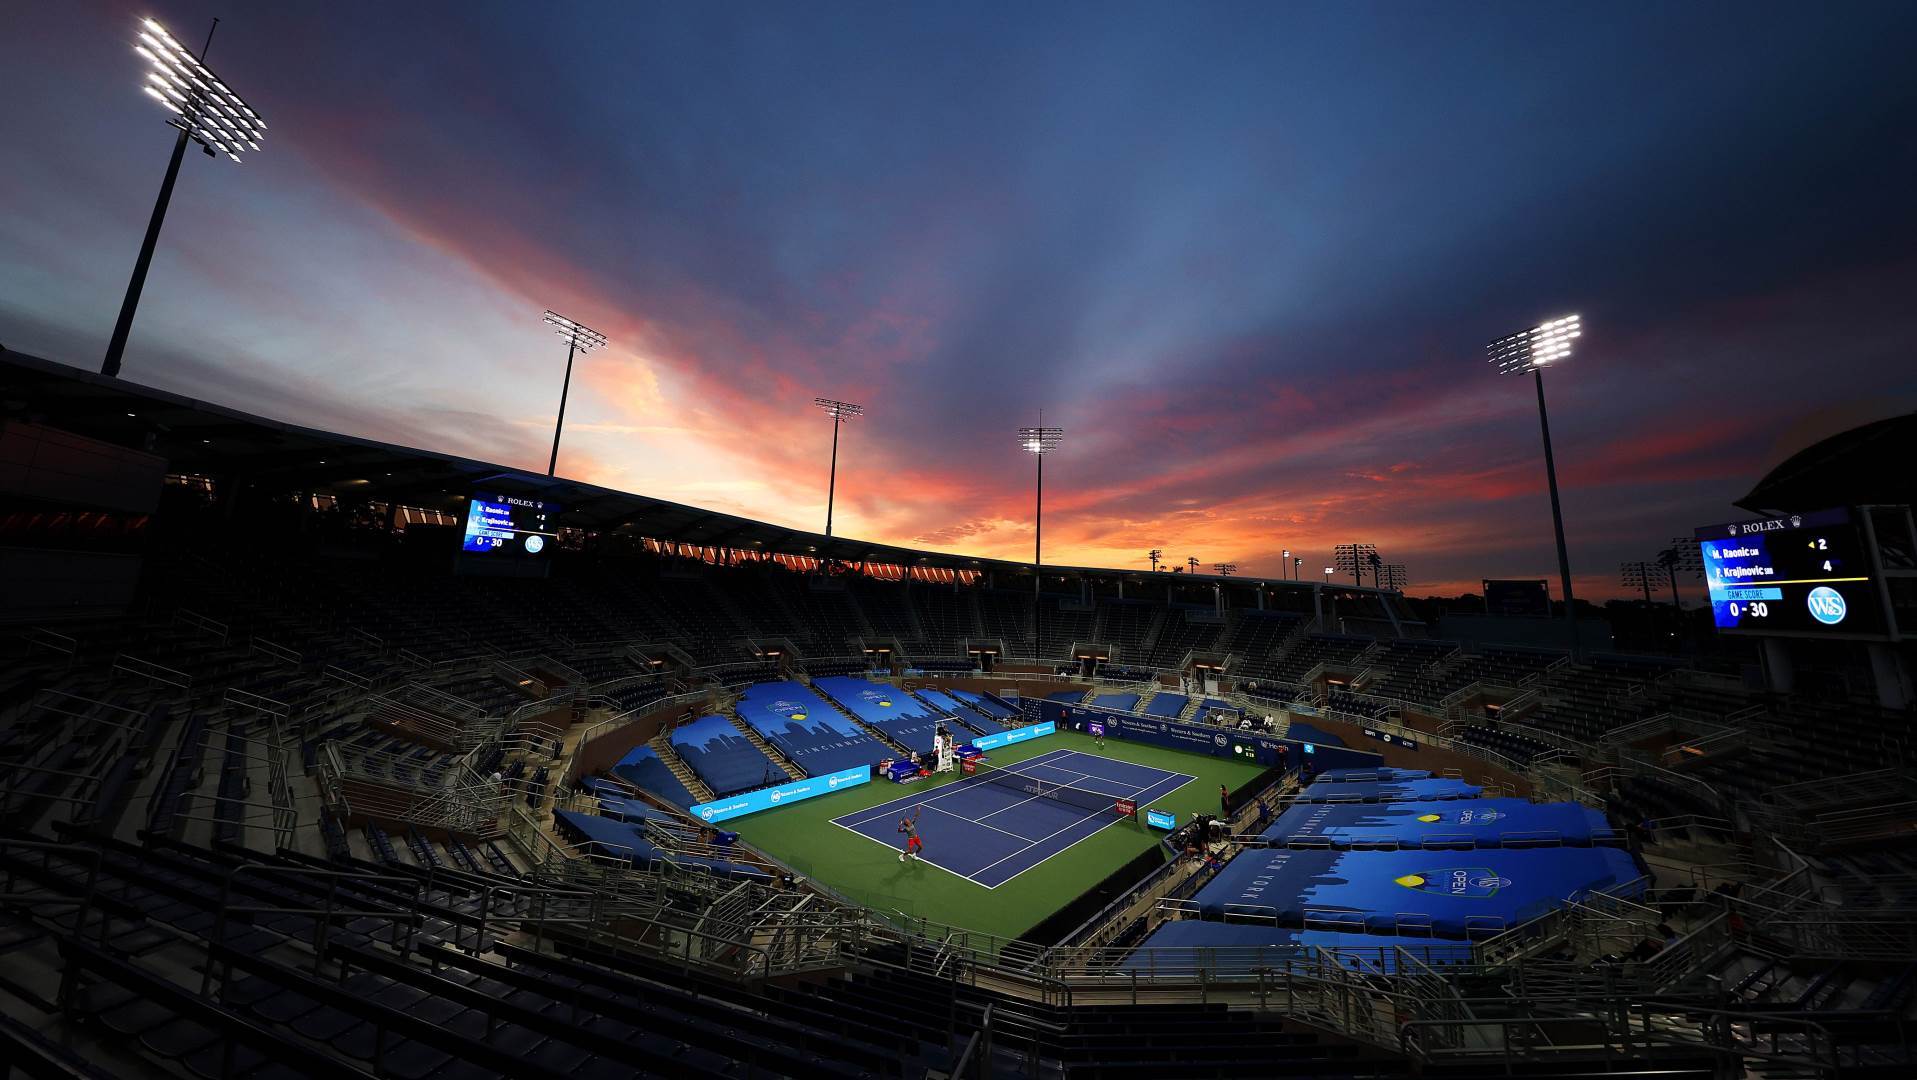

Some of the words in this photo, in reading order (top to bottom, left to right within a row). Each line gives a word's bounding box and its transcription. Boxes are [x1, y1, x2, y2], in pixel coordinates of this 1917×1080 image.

[507, 497, 534, 508] ROLEX
[486, 506, 504, 515] Raonic
[482, 516, 508, 526] Krajinovic
[1742, 519, 1785, 534] ROLEX
[477, 537, 484, 546] 0
[491, 537, 503, 547] 30
[1818, 538, 1828, 550] 2
[1712, 549, 1722, 559] M.
[1723, 546, 1750, 559] Raonic
[1716, 567, 1723, 578] F.
[1723, 565, 1764, 579] Krajinovic
[1823, 560, 1832, 572] 4
[1727, 590, 1743, 600] GAME
[1744, 589, 1764, 600] SCORE
[1730, 602, 1740, 617] 0
[1750, 602, 1768, 617] 30
[795, 736, 873, 756] CINCINNATI
[1265, 854, 1292, 870] NEW
[1240, 875, 1275, 899] YORK
[1452, 870, 1467, 895] OPEN
